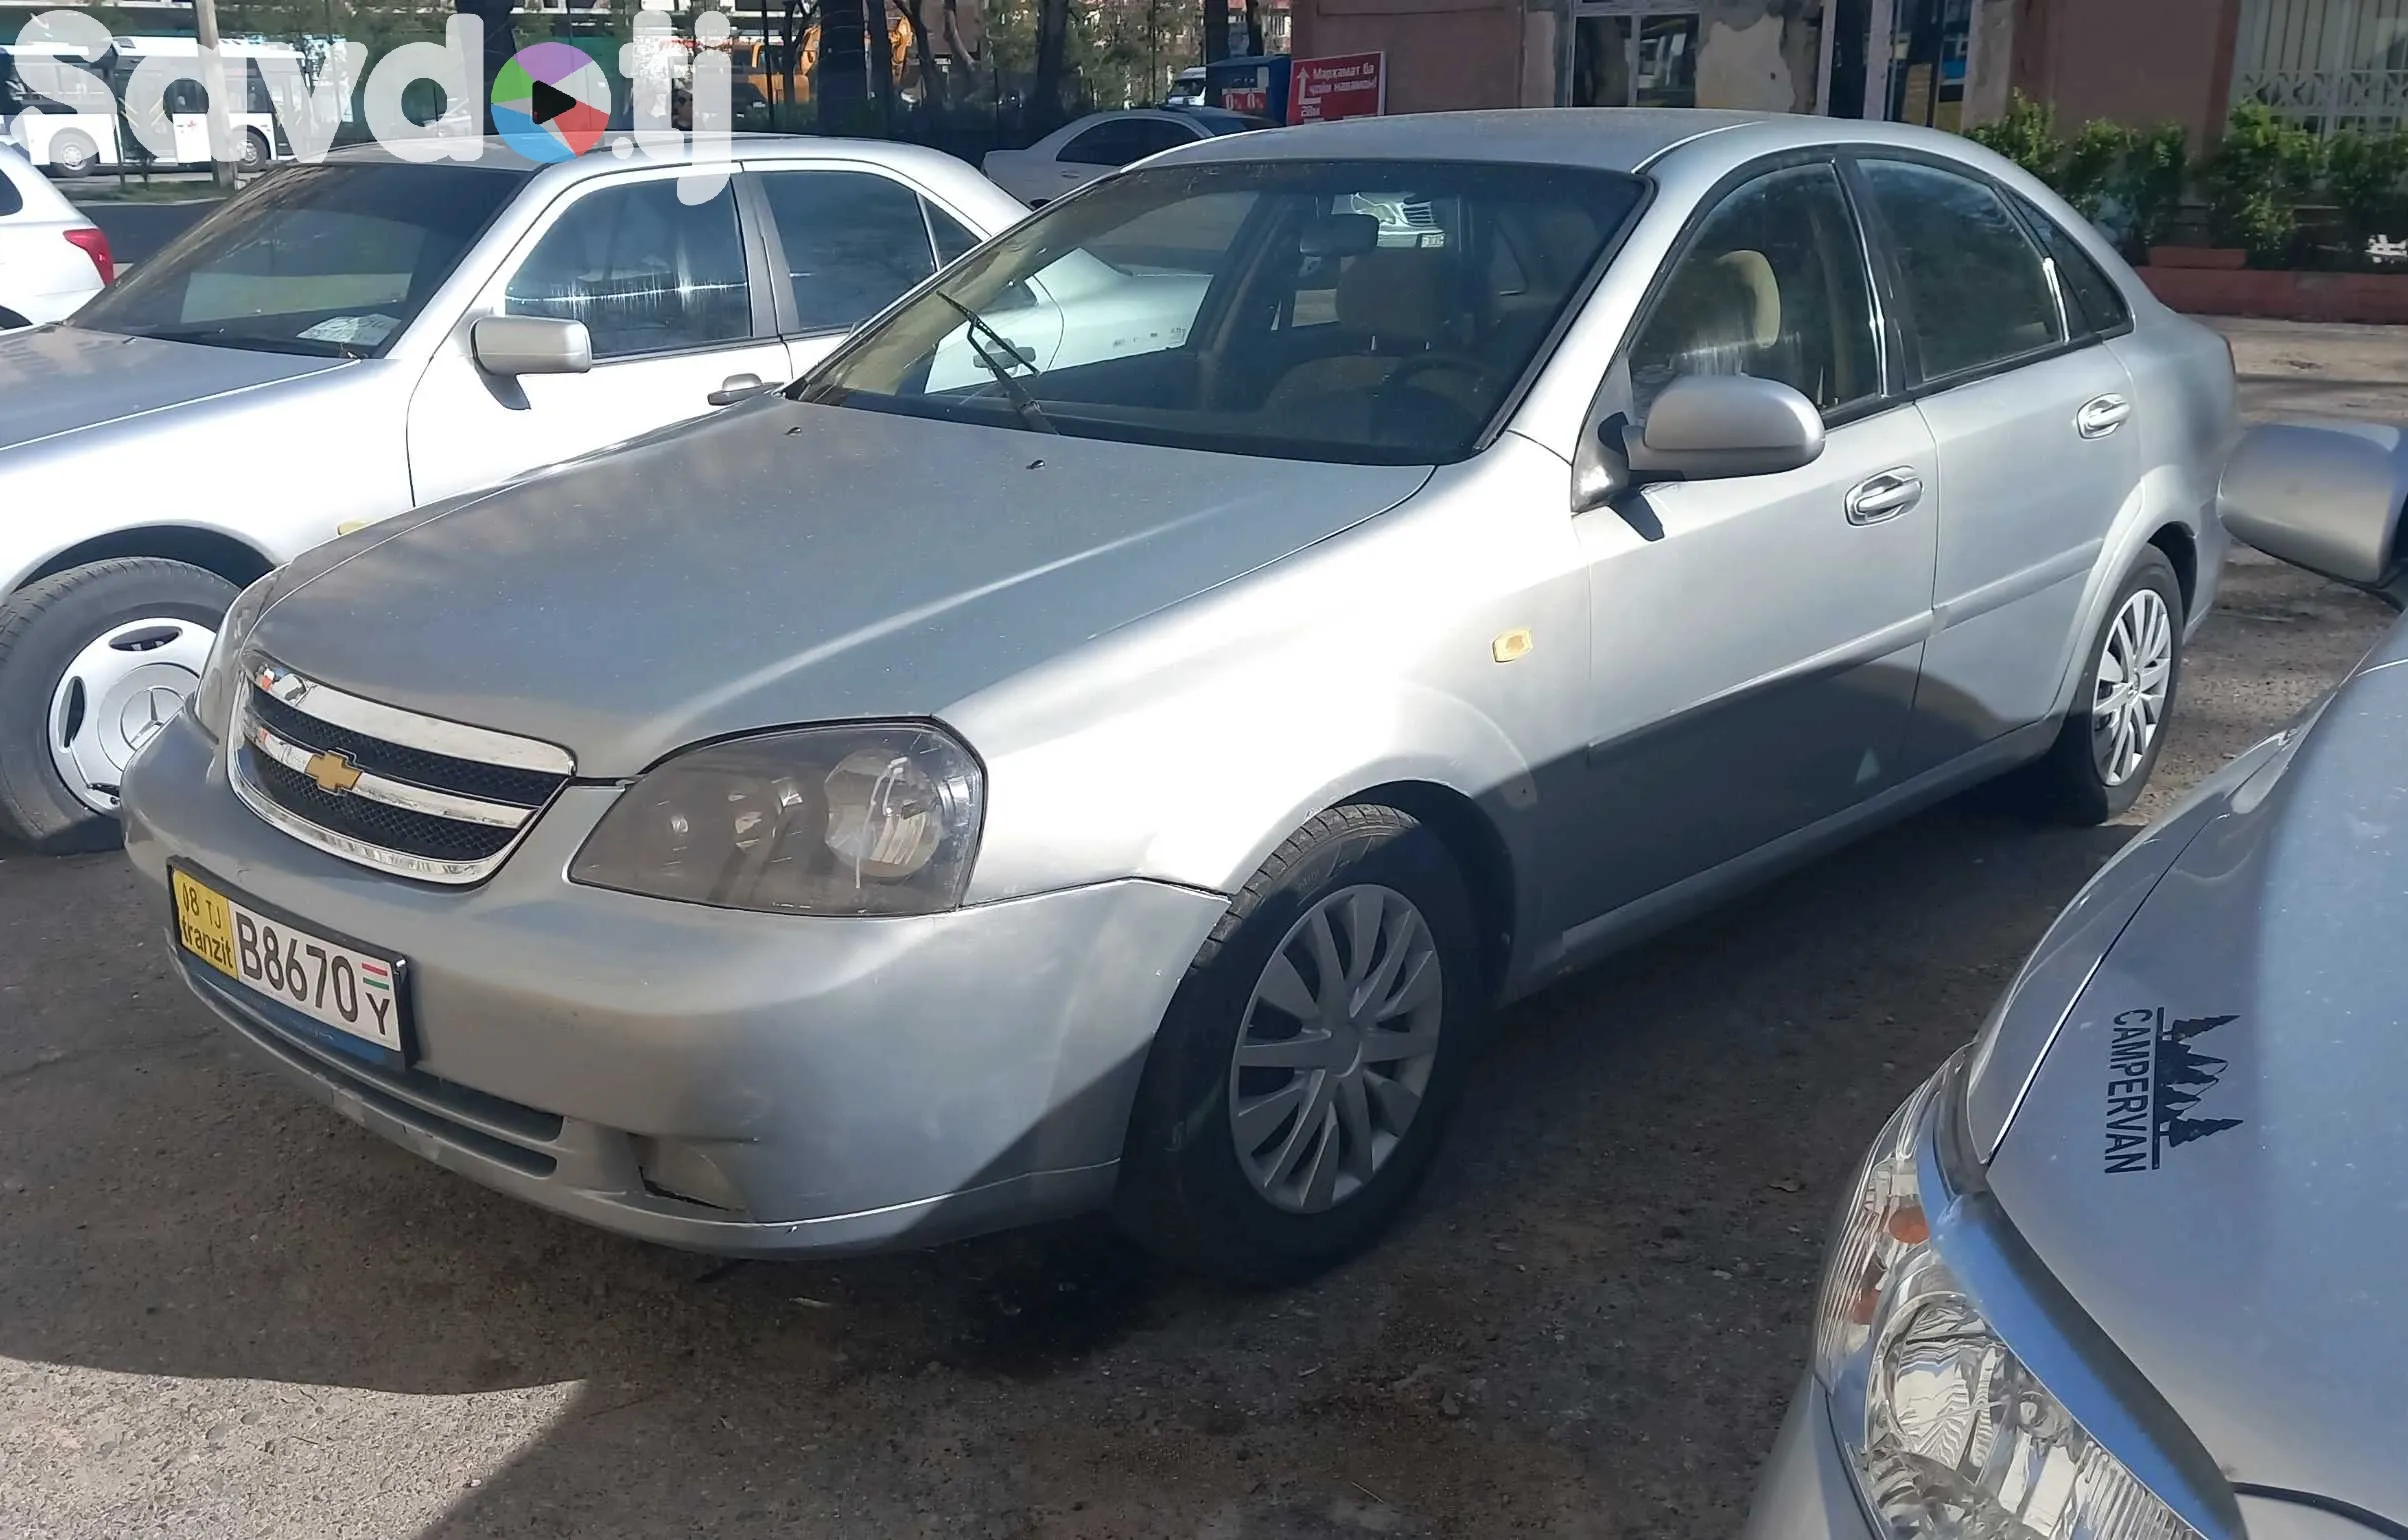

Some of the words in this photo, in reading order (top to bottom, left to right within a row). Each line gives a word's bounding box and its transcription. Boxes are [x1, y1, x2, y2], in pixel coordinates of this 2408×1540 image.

[181, 915, 233, 968] tranzit
[205, 900, 222, 929] TJ
[235, 911, 359, 1023] B8670
[366, 992, 391, 1036] Y
[2104, 1008, 2153, 1174] CAMPERVAN
